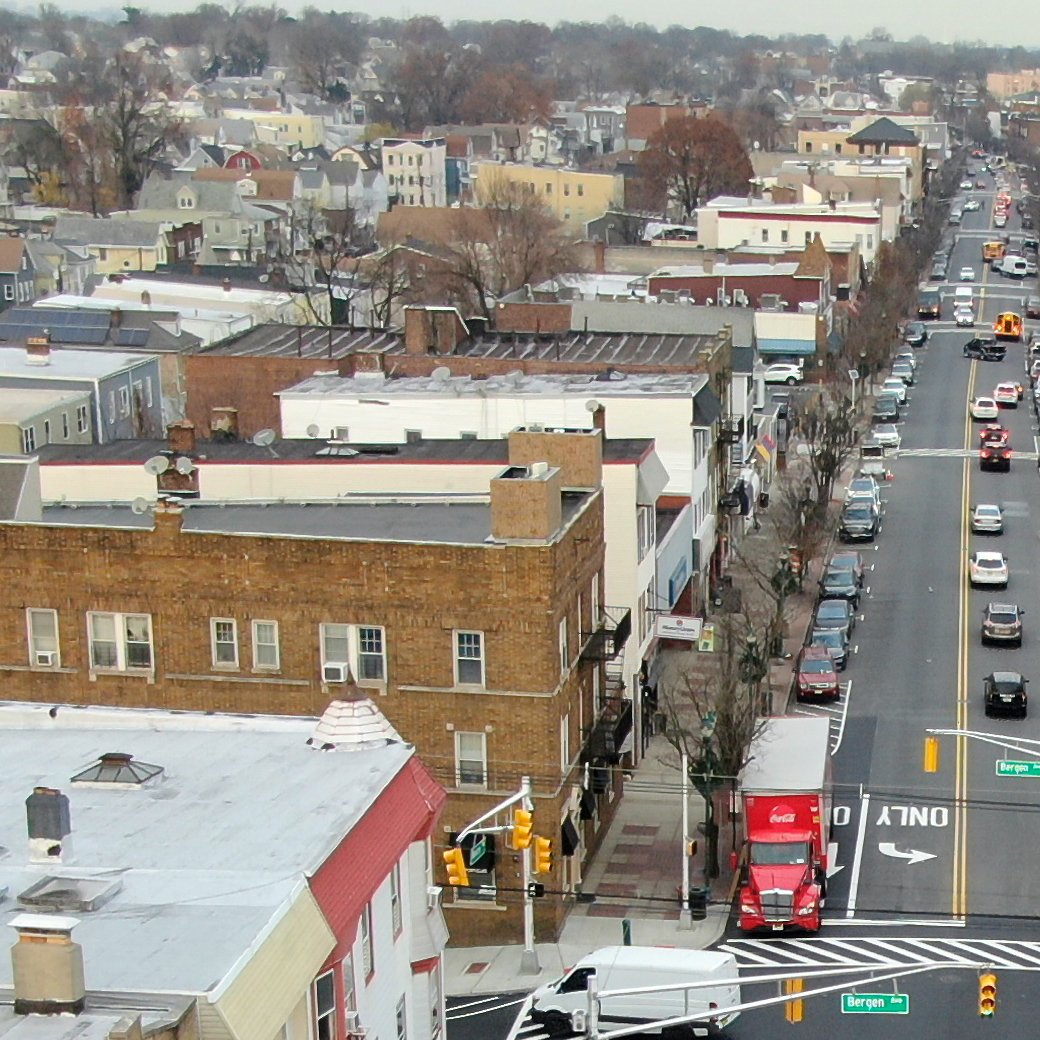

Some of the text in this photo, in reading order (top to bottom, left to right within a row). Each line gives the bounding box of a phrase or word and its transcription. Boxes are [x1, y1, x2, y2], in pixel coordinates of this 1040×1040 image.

[1000, 762, 1029, 775] Bergen
[876, 806, 948, 826] ONLY
[847, 996, 885, 1011] Bergen
